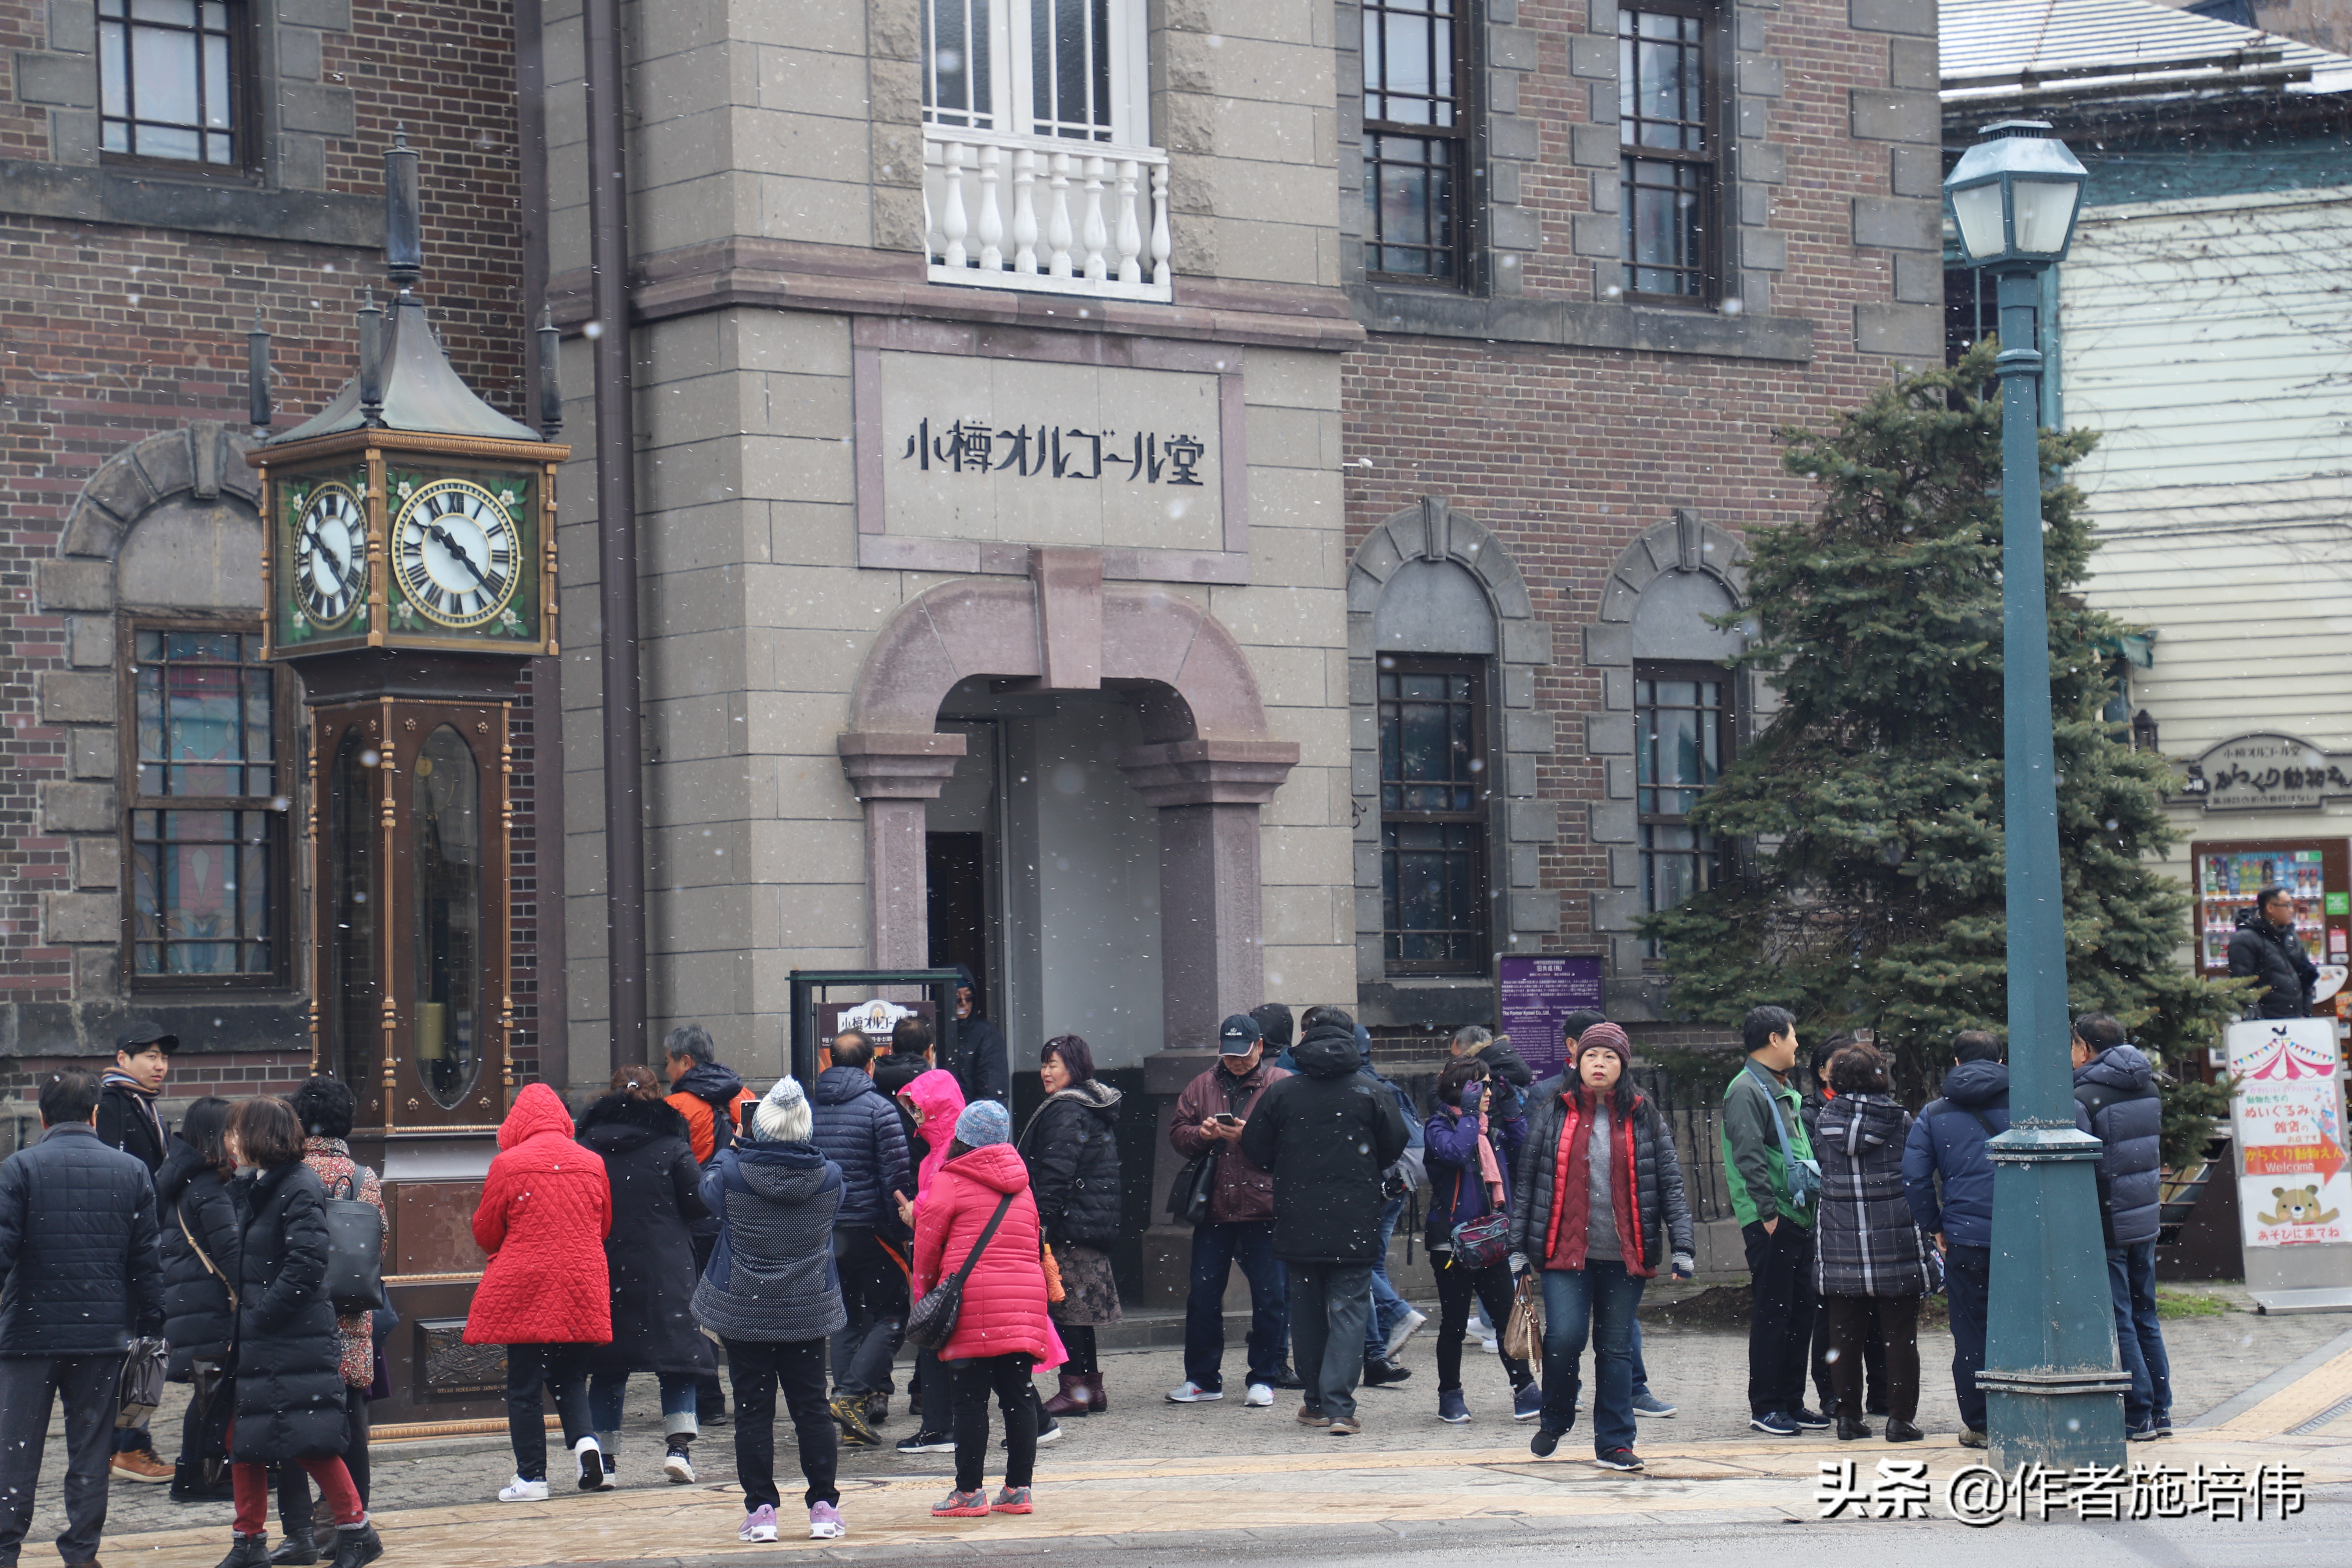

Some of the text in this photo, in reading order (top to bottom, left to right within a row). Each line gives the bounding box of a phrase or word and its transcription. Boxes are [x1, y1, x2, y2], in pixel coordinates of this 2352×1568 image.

[902, 417, 1204, 485] 小樽オルゴール堂
[2246, 1095, 2288, 1104] 動物たちの
[2274, 1120, 2309, 1133] 雑貨の
[2245, 1147, 2343, 1162] からくり動物えん
[2265, 1162, 2315, 1173] Welcome
[2258, 1227, 2340, 1241] あそびに来てね
